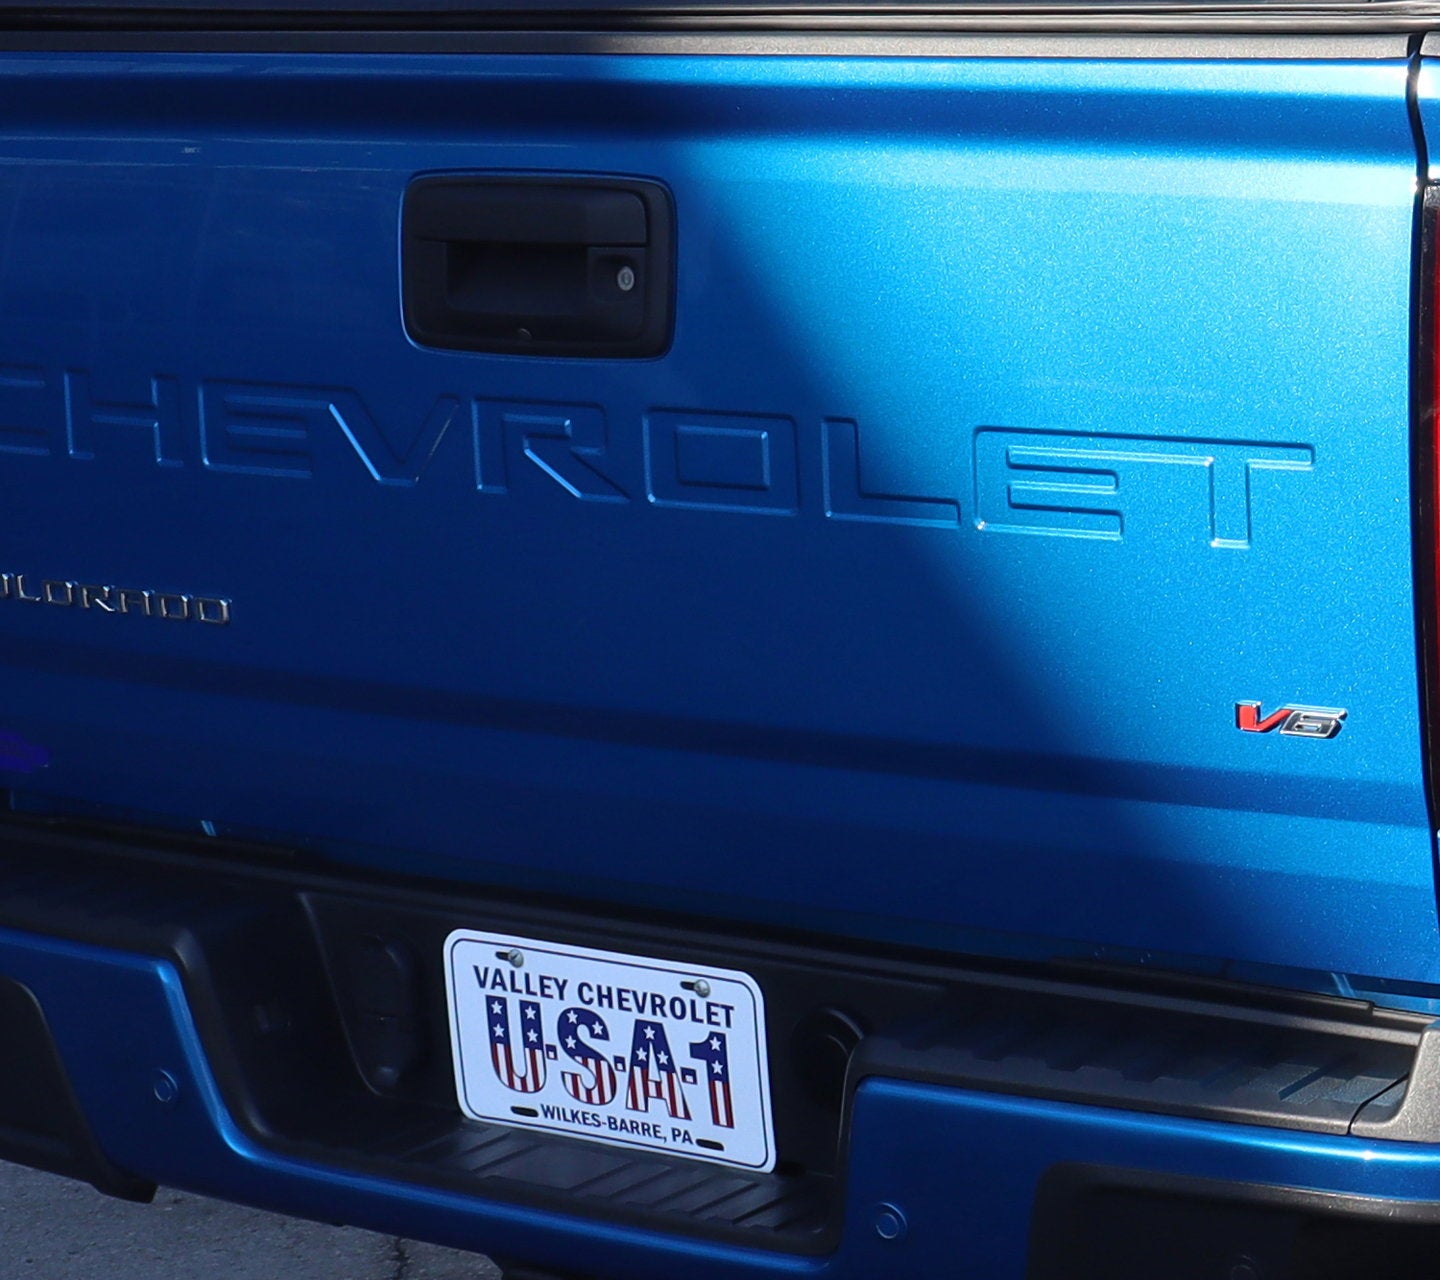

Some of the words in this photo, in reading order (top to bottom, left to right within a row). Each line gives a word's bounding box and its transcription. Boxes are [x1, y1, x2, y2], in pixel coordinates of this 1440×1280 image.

[1235, 699, 1348, 740] V6
[473, 965, 569, 1001] VALLEY
[577, 981, 735, 1028] CHEVROLET
[540, 1104, 667, 1144] WILKES-BARRE,
[671, 1127, 694, 1146] PA
